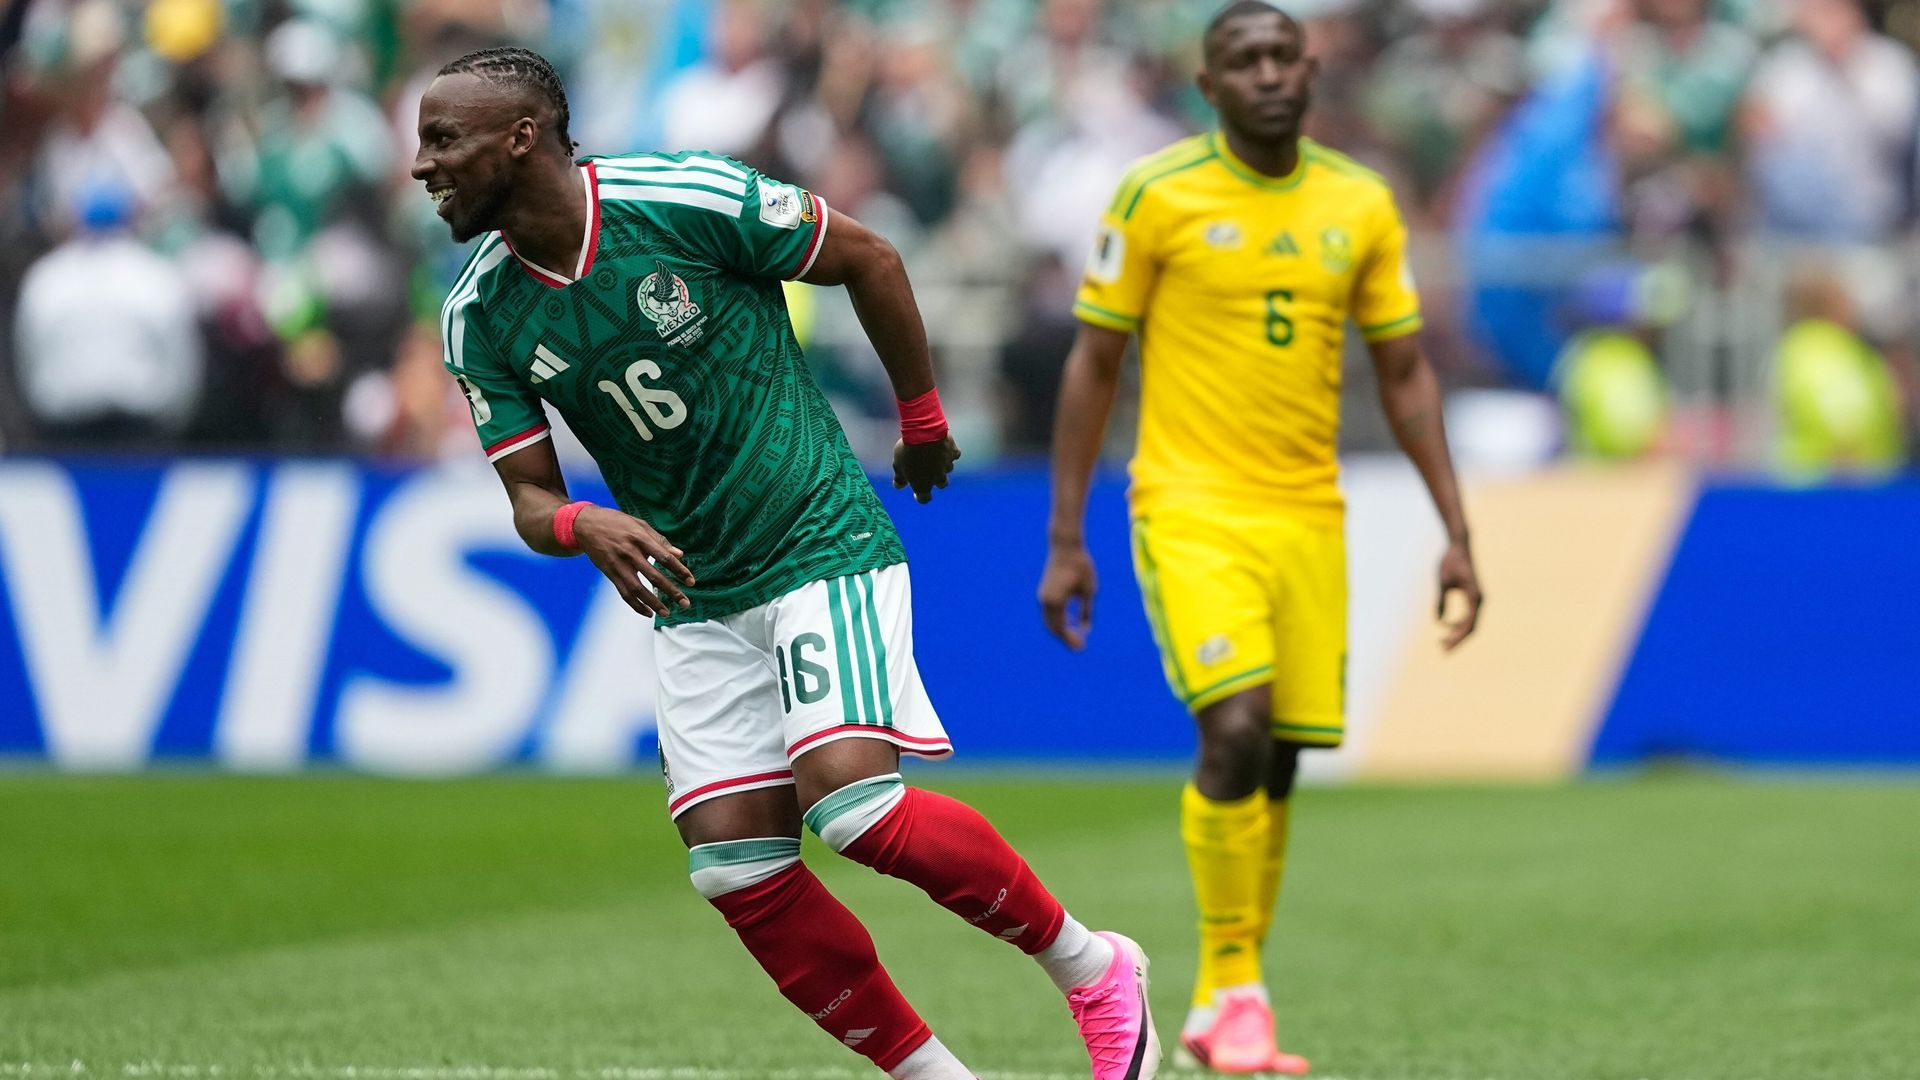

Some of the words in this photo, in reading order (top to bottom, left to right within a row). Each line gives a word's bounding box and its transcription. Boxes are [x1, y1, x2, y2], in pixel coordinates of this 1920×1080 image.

[659, 306, 698, 336] MÉXICO
[1264, 289, 1294, 347] 6
[598, 359, 687, 441] 16
[775, 632, 831, 714] 16
